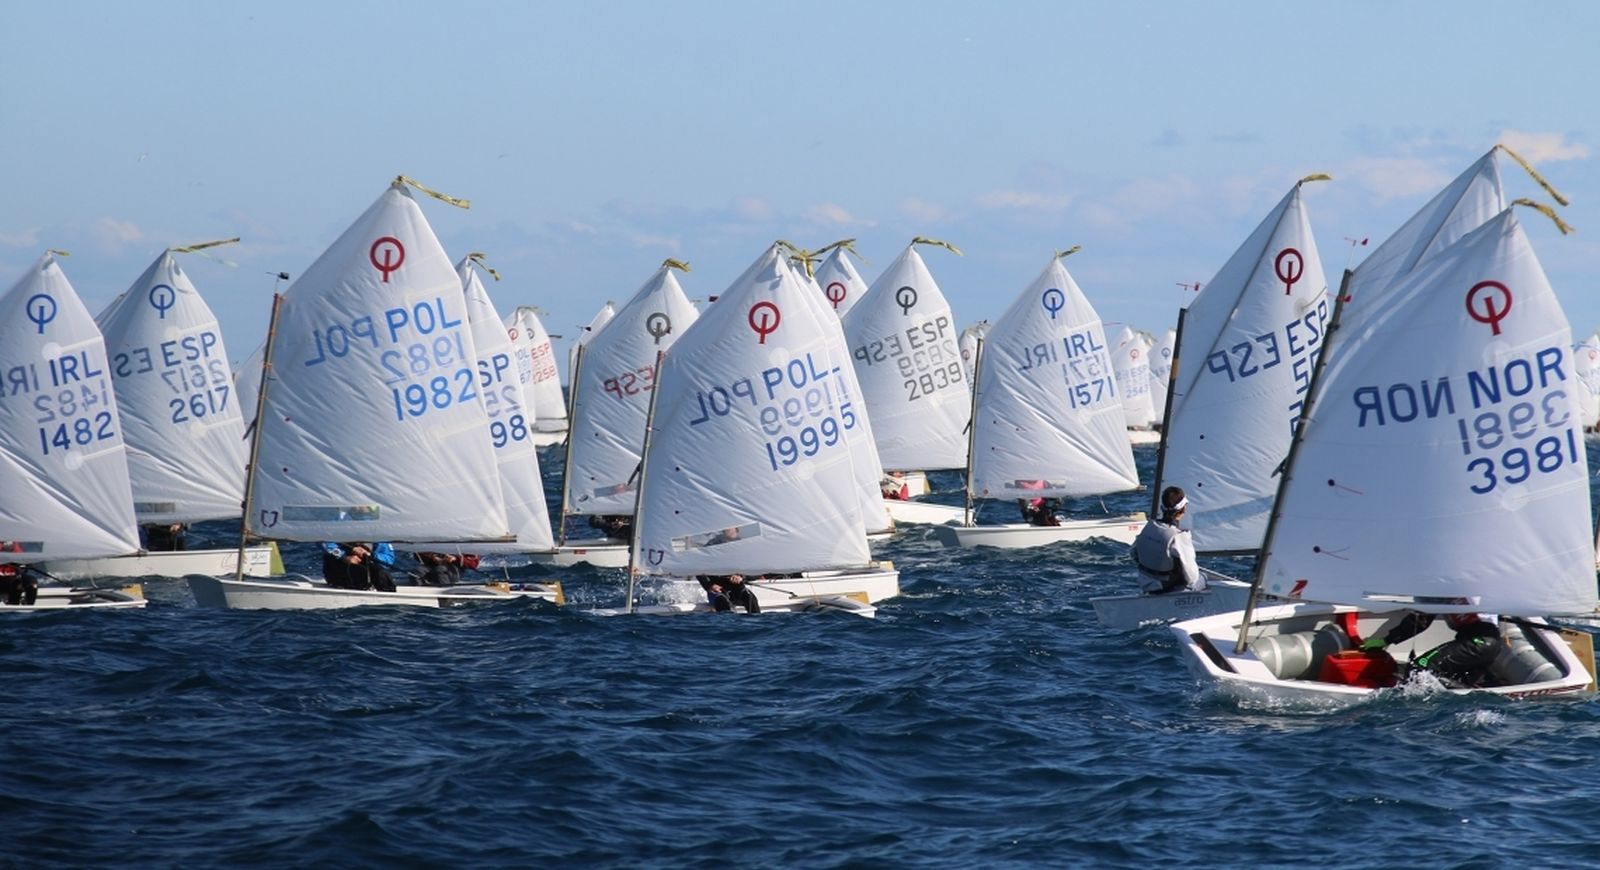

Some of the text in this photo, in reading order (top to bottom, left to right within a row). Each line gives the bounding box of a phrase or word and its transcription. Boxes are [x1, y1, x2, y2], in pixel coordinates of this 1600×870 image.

[385, 297, 462, 343] POL
[906, 316, 948, 350] ESP
[1286, 300, 1327, 357] ESP
[160, 331, 217, 368] ESP
[531, 342, 549, 360] ESP
[1063, 330, 1103, 359] IRL
[49, 351, 102, 387] IRL
[904, 361, 961, 401] 2839
[1467, 347, 1566, 409] NOR
[169, 386, 229, 424] 2617
[392, 367, 477, 421] 1982
[1068, 375, 1115, 409] 1571
[39, 411, 115, 455] 1482
[489, 414, 527, 448] 98
[1466, 428, 1578, 494] 3981
